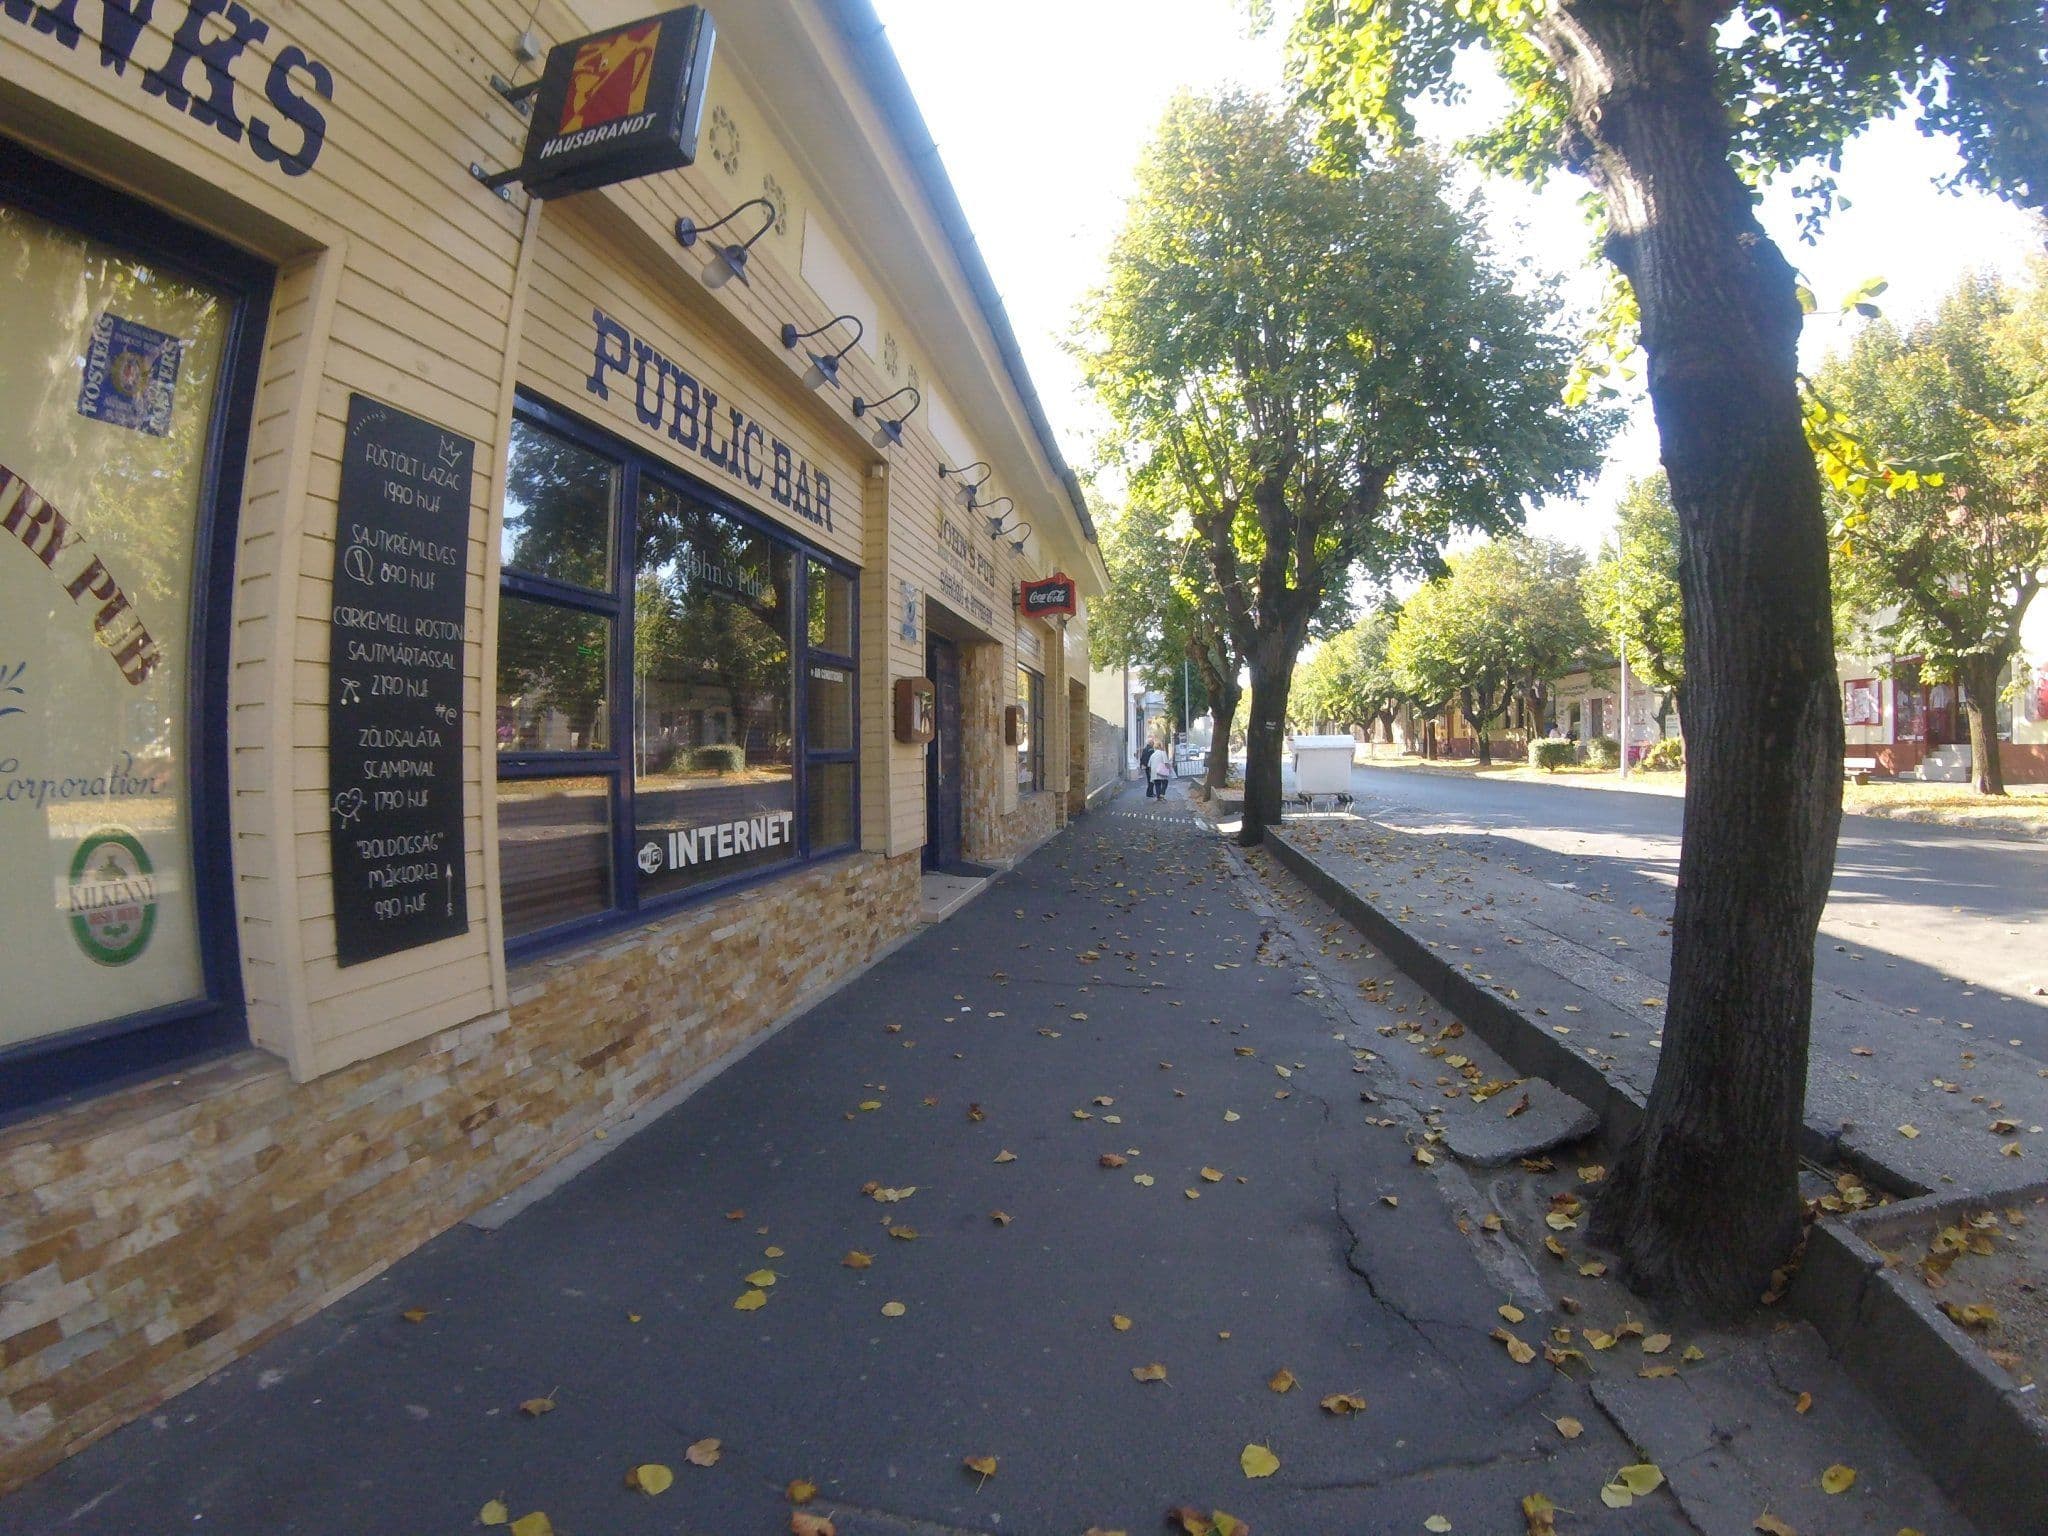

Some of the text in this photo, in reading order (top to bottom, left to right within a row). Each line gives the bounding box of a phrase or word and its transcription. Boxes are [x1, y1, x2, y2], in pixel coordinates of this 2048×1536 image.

[540, 112, 657, 160] HAUSBRANDT
[585, 307, 834, 534] PUBLIC BAR
[384, 480, 413, 505] 1990
[421, 463, 461, 491] LAZAC
[63, 553, 161, 686] PUB
[415, 618, 463, 640] ROSTON
[668, 811, 794, 870] INTERNET
[375, 898, 401, 920] 990
